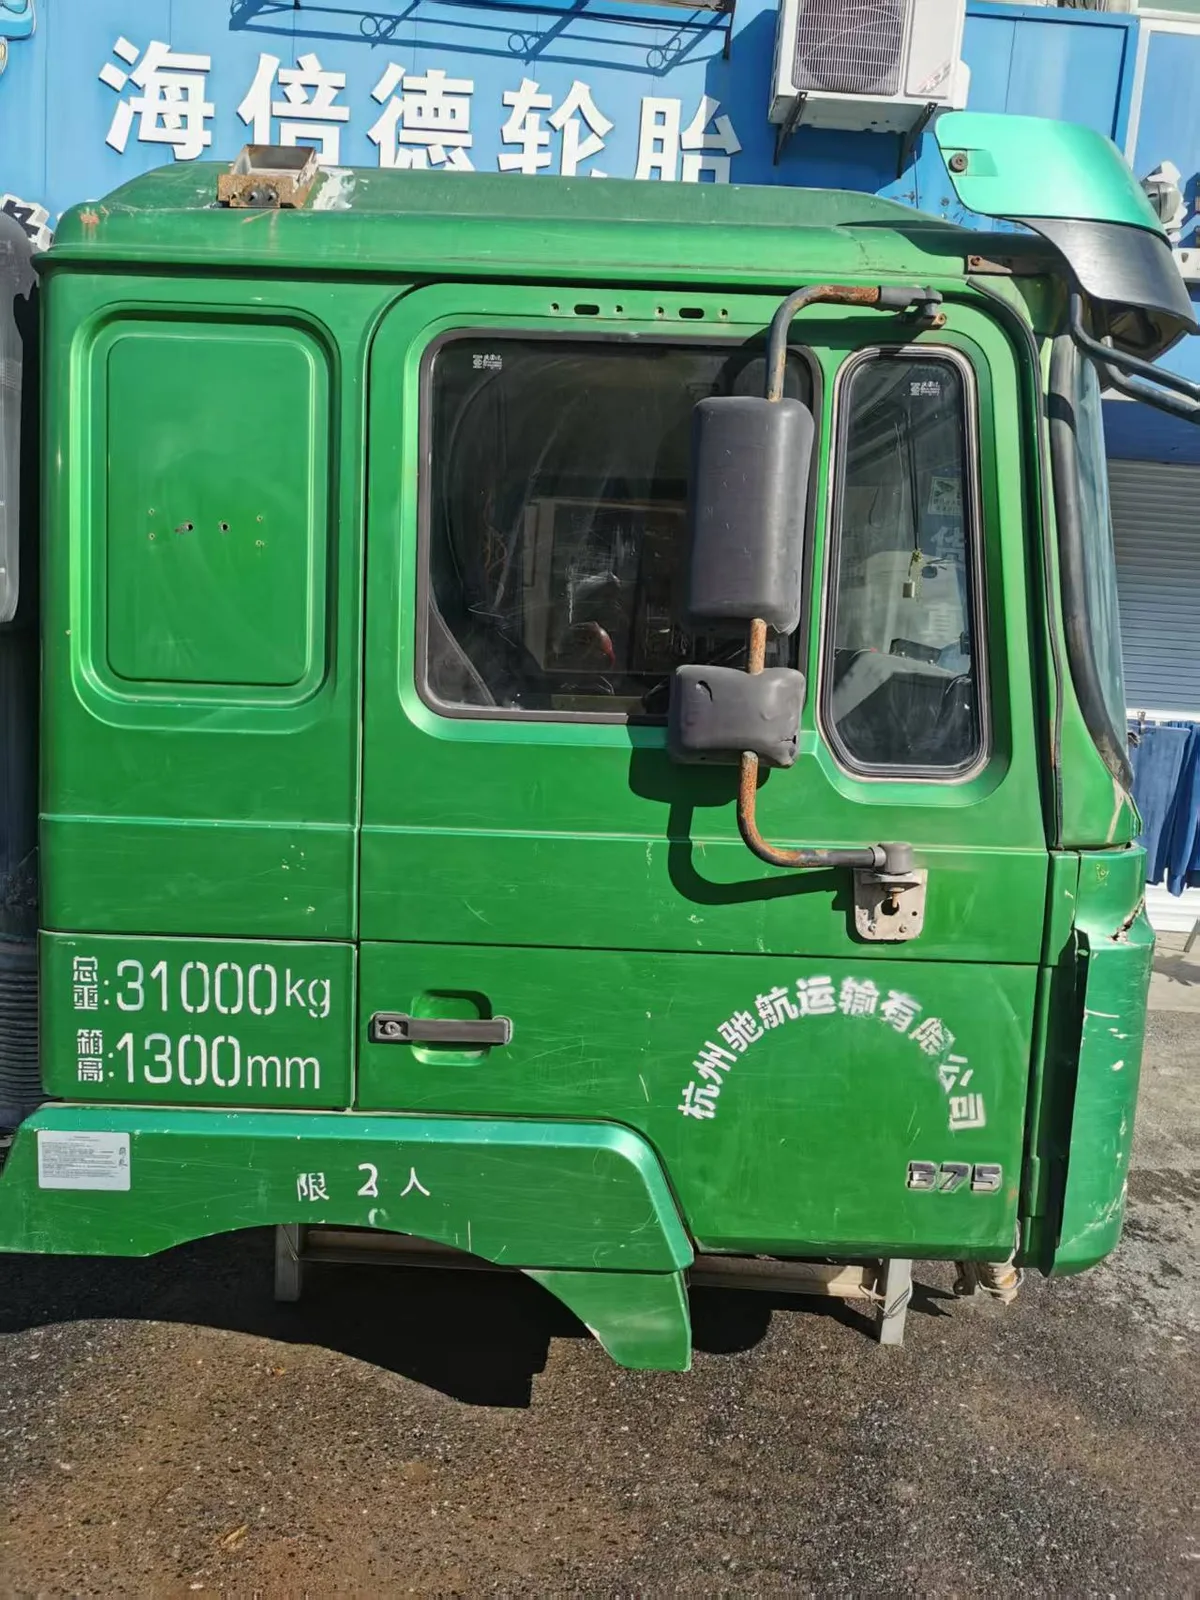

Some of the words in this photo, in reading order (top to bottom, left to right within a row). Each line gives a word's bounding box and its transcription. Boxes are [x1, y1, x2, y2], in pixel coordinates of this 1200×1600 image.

[99, 37, 742, 184] 海倍德轮胎
[678, 976, 986, 1130] 杭州驰航运输有限公司
